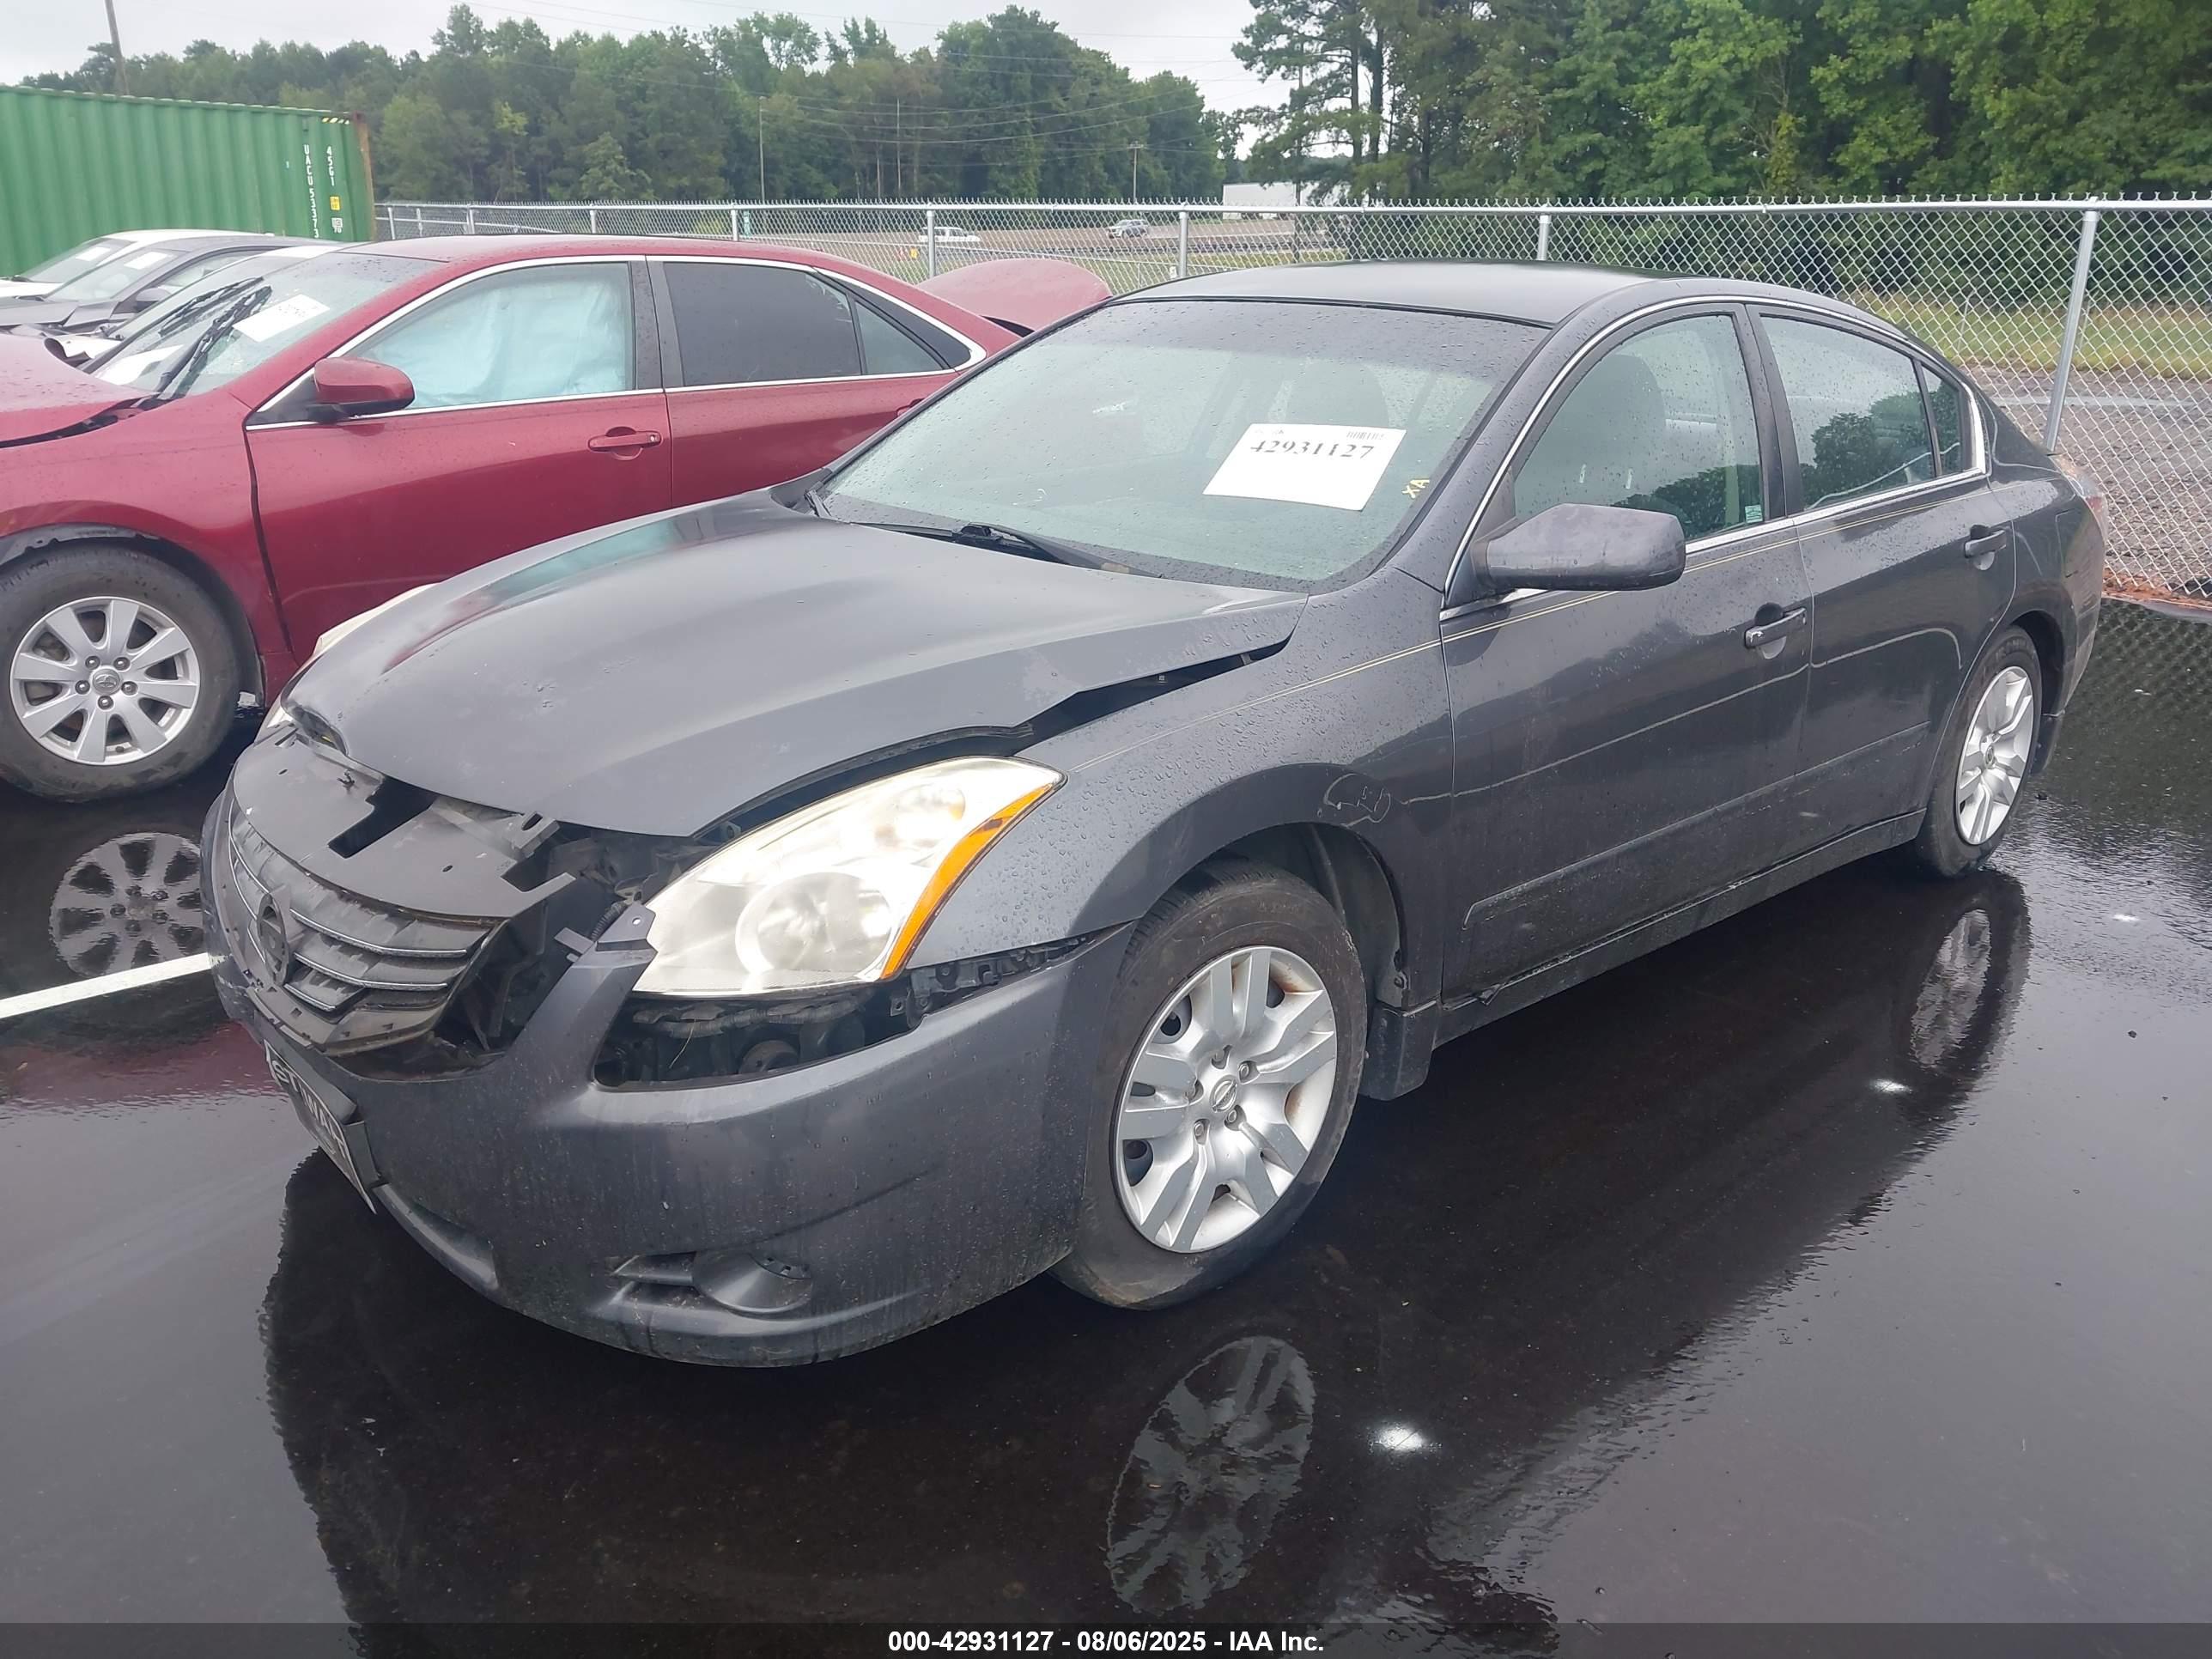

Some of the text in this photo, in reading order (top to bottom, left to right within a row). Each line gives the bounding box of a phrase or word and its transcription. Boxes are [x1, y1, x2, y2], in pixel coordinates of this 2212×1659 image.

[304, 144, 313, 185] UACU
[326, 146, 335, 186] 45G1
[1250, 440, 1375, 459] 42931127
